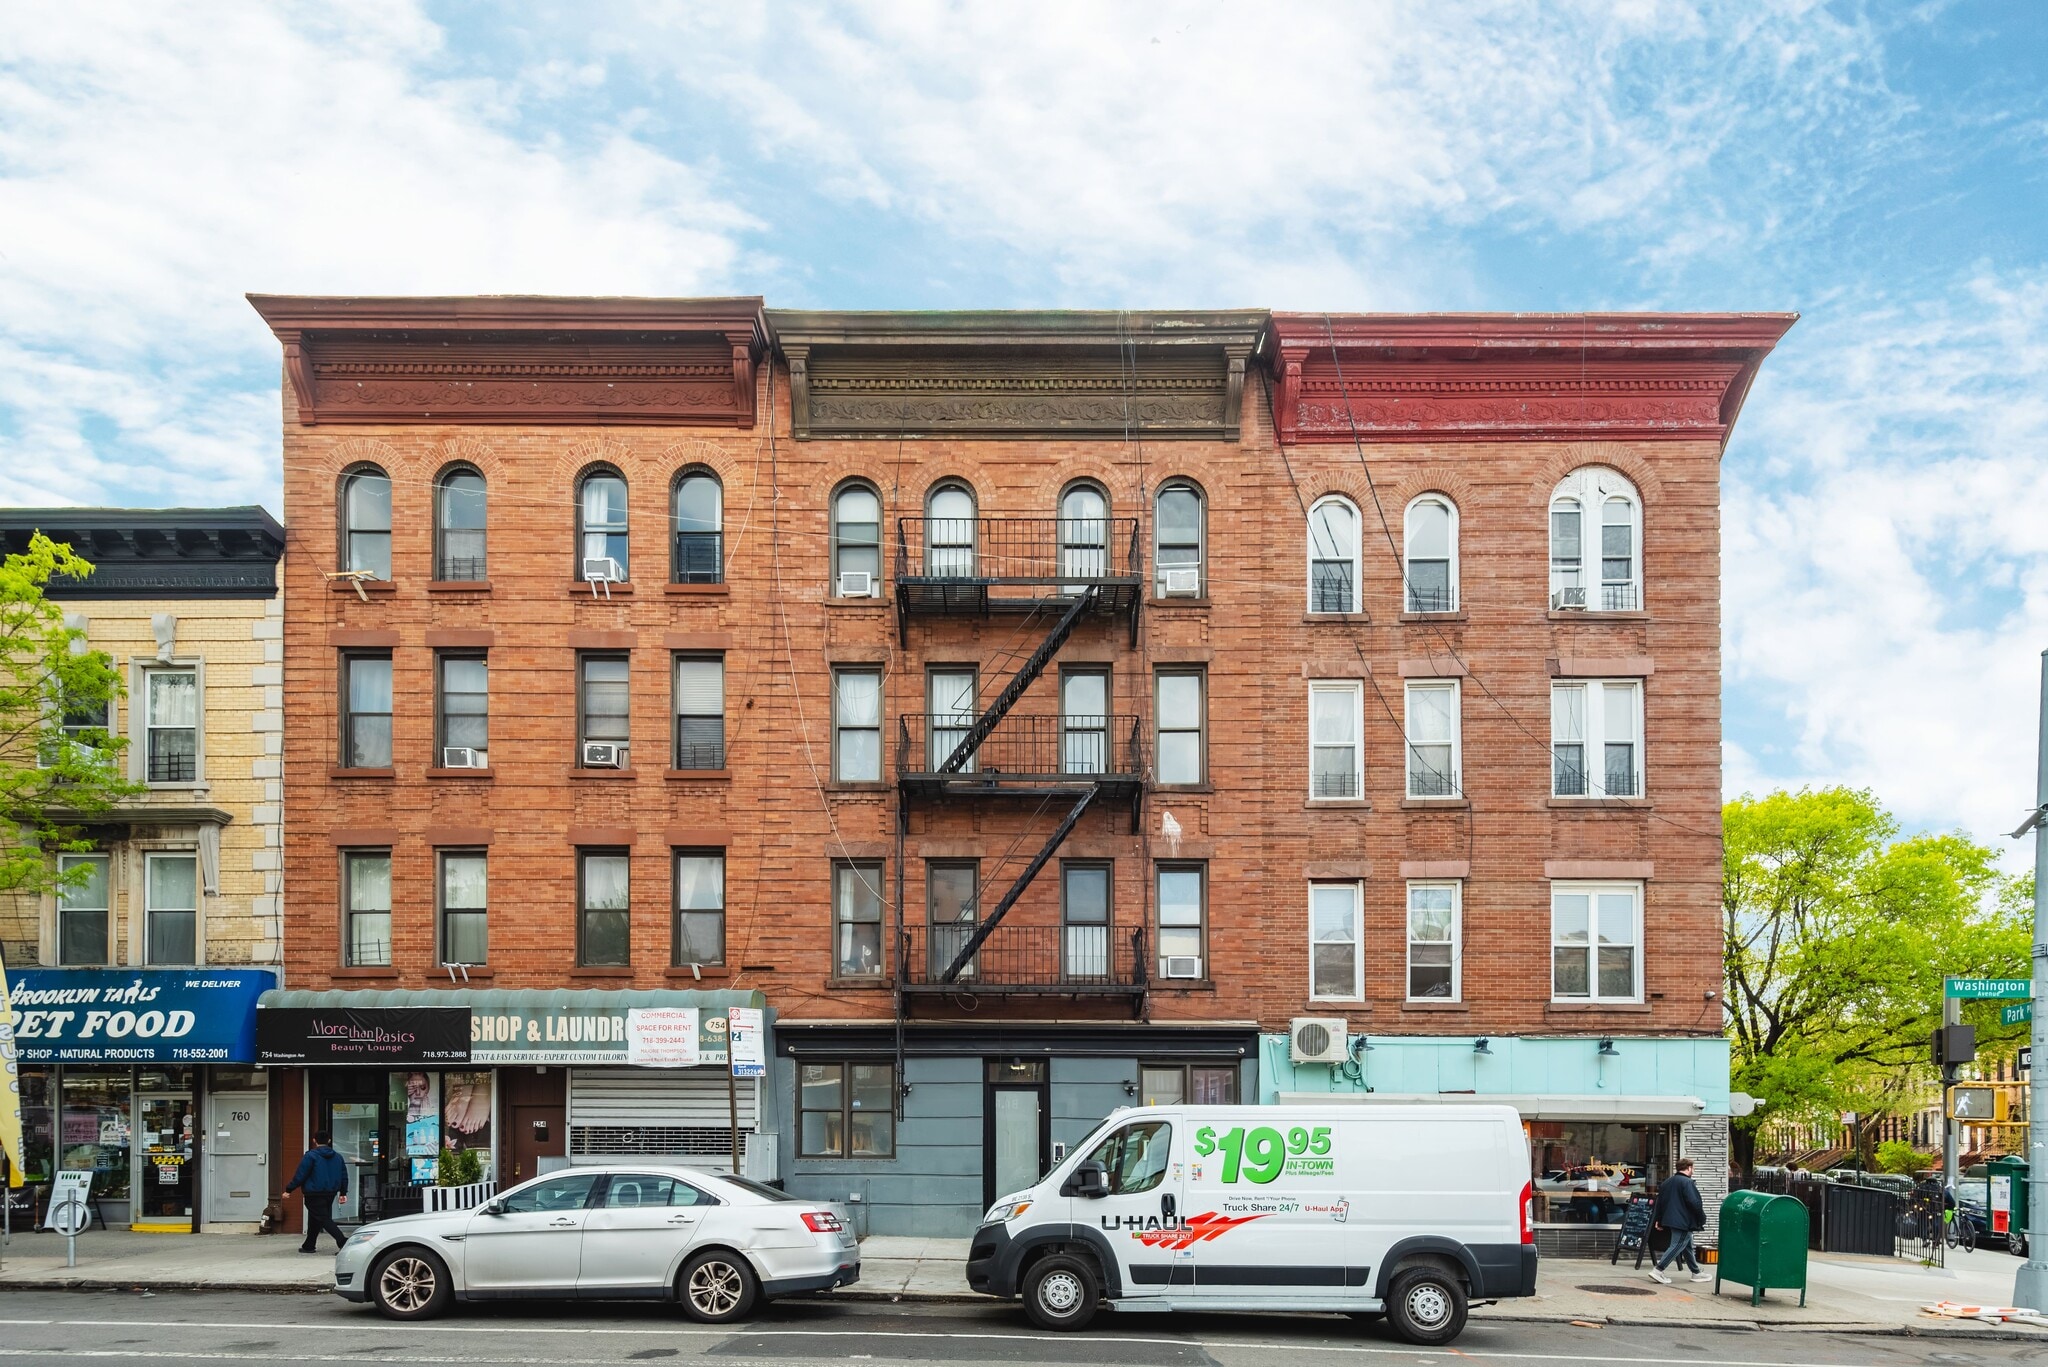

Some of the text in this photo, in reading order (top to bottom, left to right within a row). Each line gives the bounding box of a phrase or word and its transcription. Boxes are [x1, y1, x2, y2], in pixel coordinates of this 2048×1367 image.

[201, 980, 241, 988] DELIVER
[1954, 980, 2025, 993] Washington
[2006, 1005, 2025, 1023] Park
[77, 1010, 196, 1038] FOOD
[471, 1016, 522, 1042] SHOP
[526, 1019, 541, 1042] &
[636, 1024, 657, 1032] SPACE
[710, 1021, 725, 1029] 754
[311, 1019, 415, 1043] More than Basics
[733, 1032, 740, 1041] 2
[331, 1043, 403, 1053] Beauty Lounge
[27, 1049, 52, 1059] SHOP
[60, 1049, 102, 1059] NATURAL
[104, 1049, 155, 1059] PRODUCTS
[173, 1048, 228, 1059] 718-552-2001
[232, 1111, 251, 1121] 760
[1286, 1161, 1334, 1170] IN-TOWN
[1223, 1203, 1300, 1213] Truck Share 24/7
[1330, 1206, 1344, 1214] App
[1101, 1215, 1193, 1232] U-HAUL
